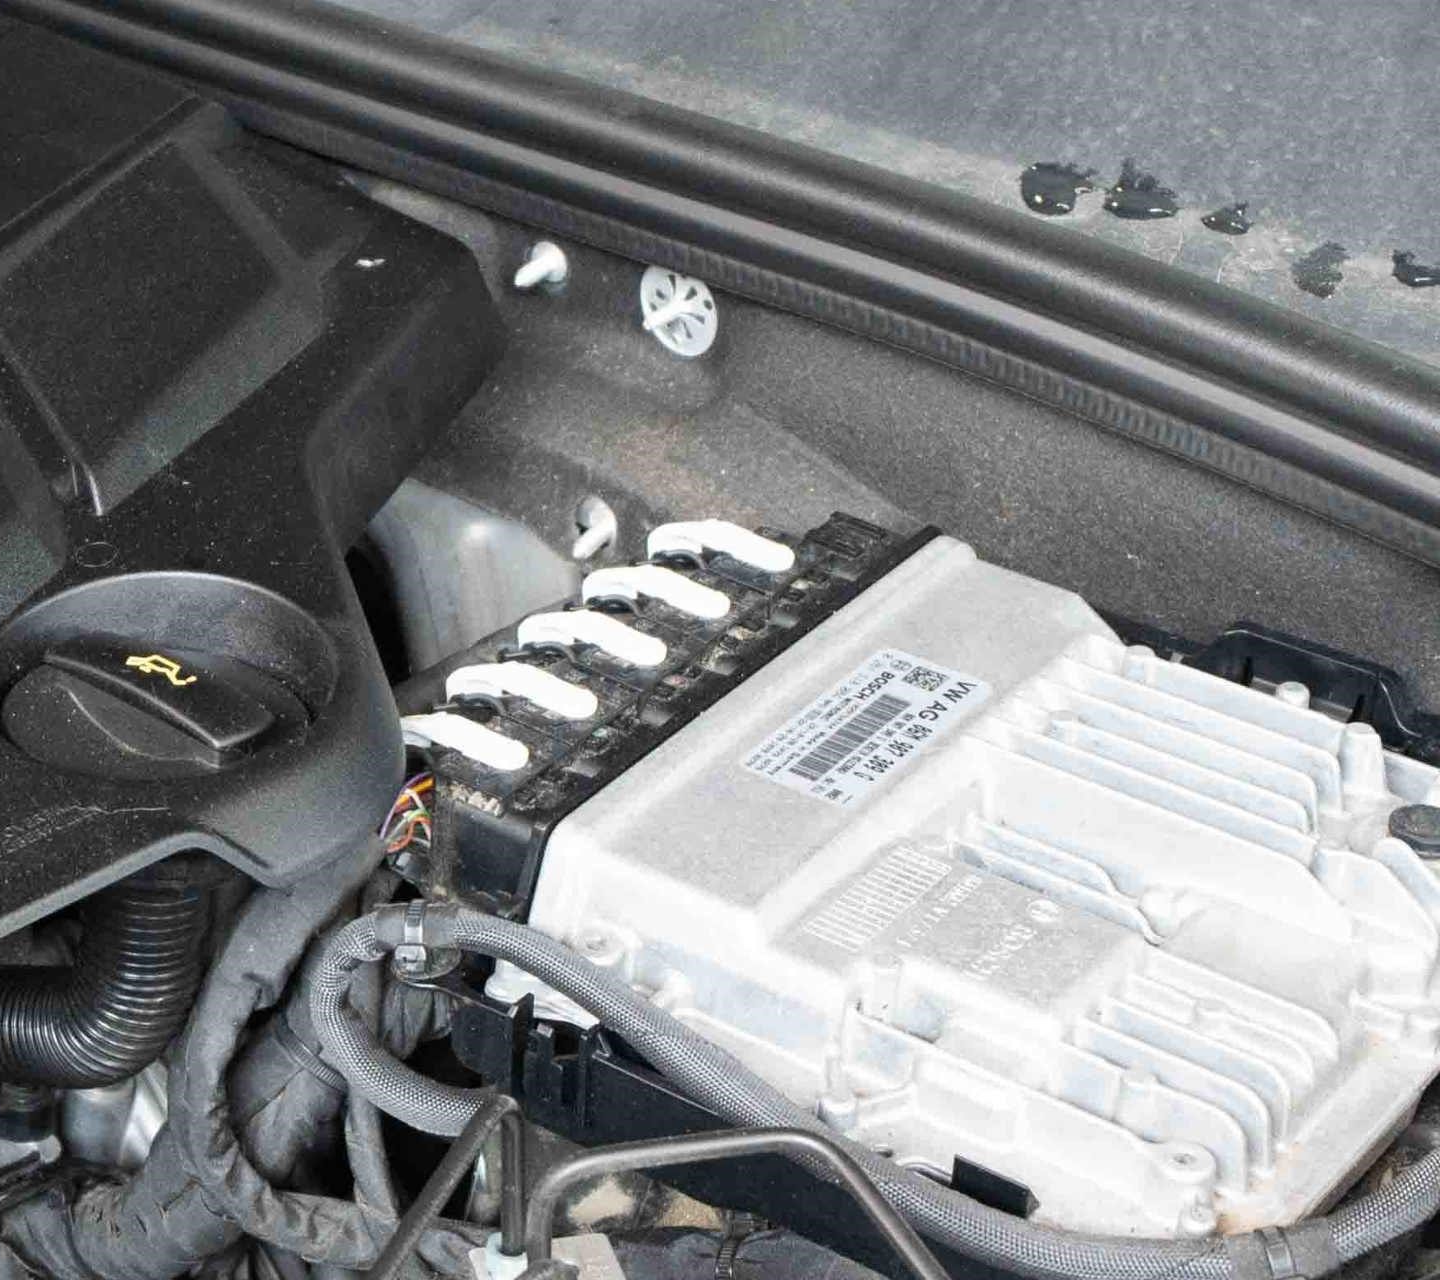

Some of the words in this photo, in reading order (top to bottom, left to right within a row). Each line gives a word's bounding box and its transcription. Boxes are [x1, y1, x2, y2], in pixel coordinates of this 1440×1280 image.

[852, 670, 896, 701] BOSCH
[942, 681, 976, 702] VW
[915, 699, 951, 722] AG
[881, 738, 914, 757] 907
